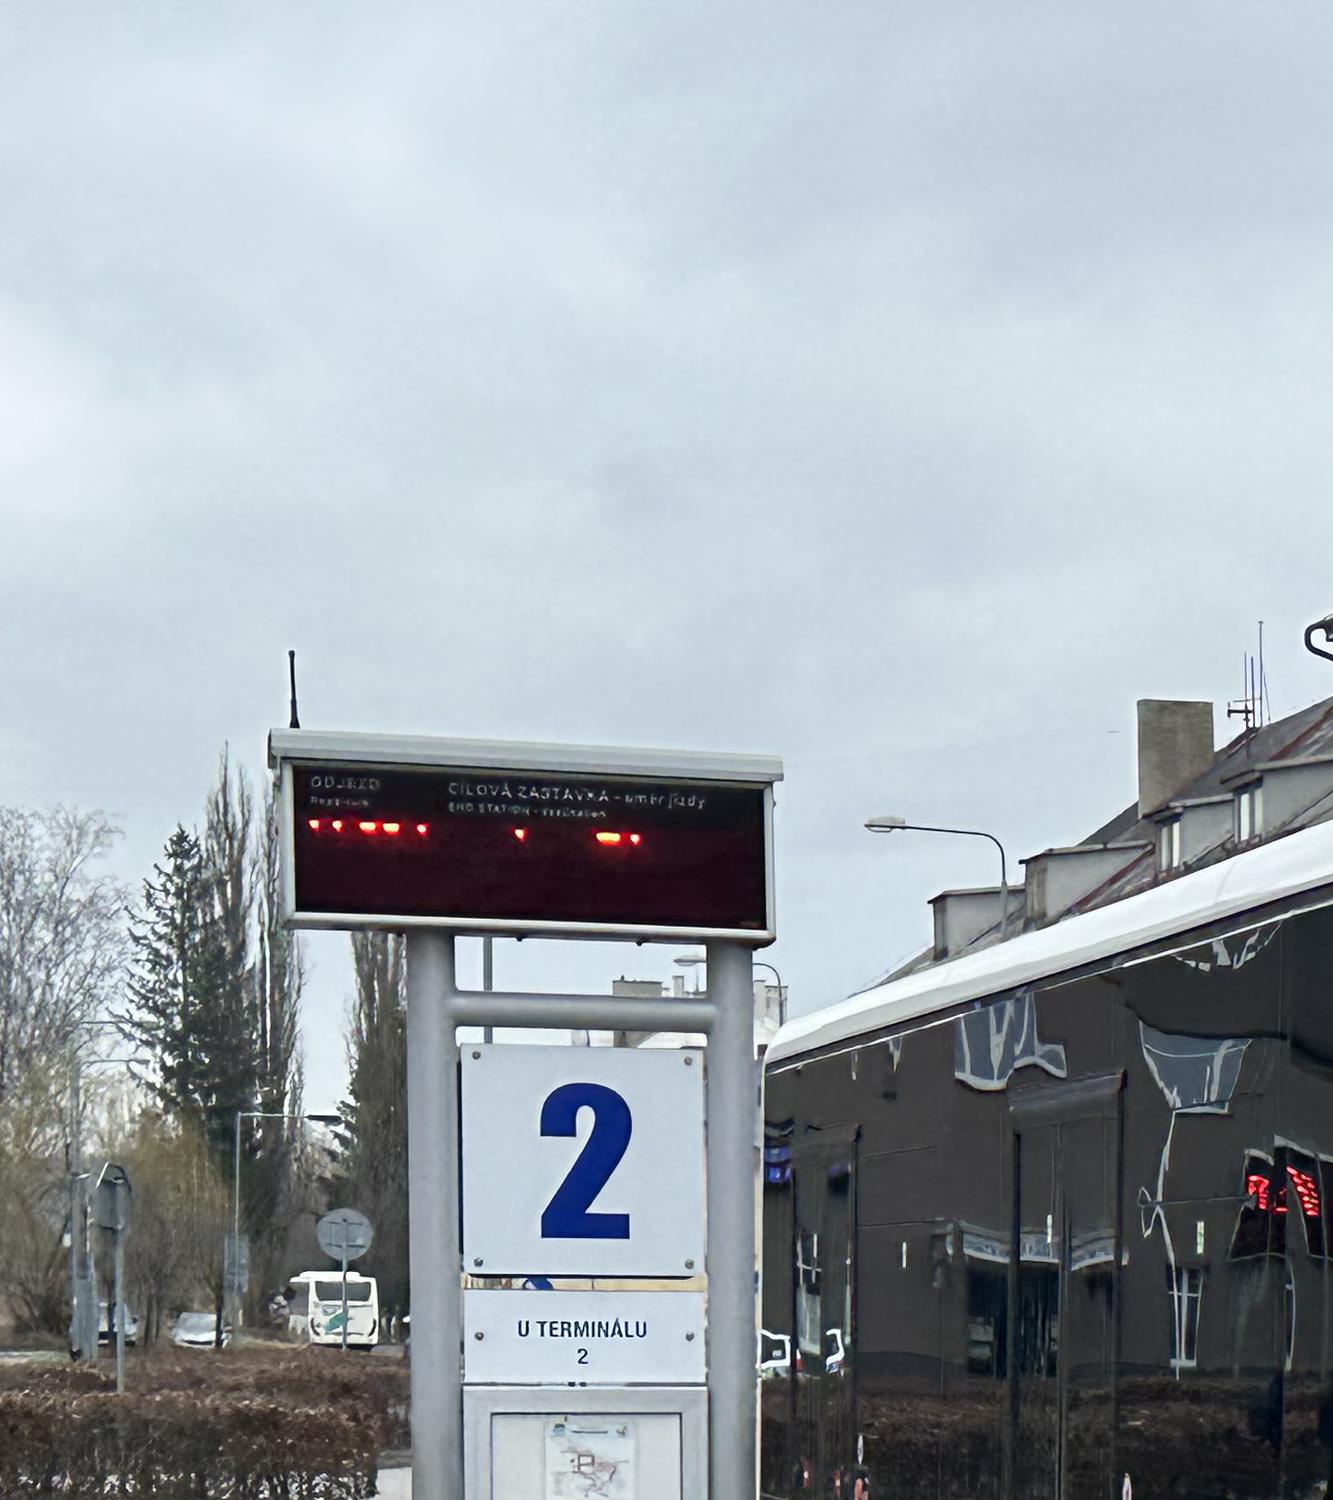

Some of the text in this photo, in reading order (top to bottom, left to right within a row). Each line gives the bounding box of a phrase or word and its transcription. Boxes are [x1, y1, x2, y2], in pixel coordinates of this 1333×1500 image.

[538, 1082, 632, 1239] 2
[518, 1318, 647, 1338] U TERMINÁLU
[577, 1348, 588, 1365] 2
